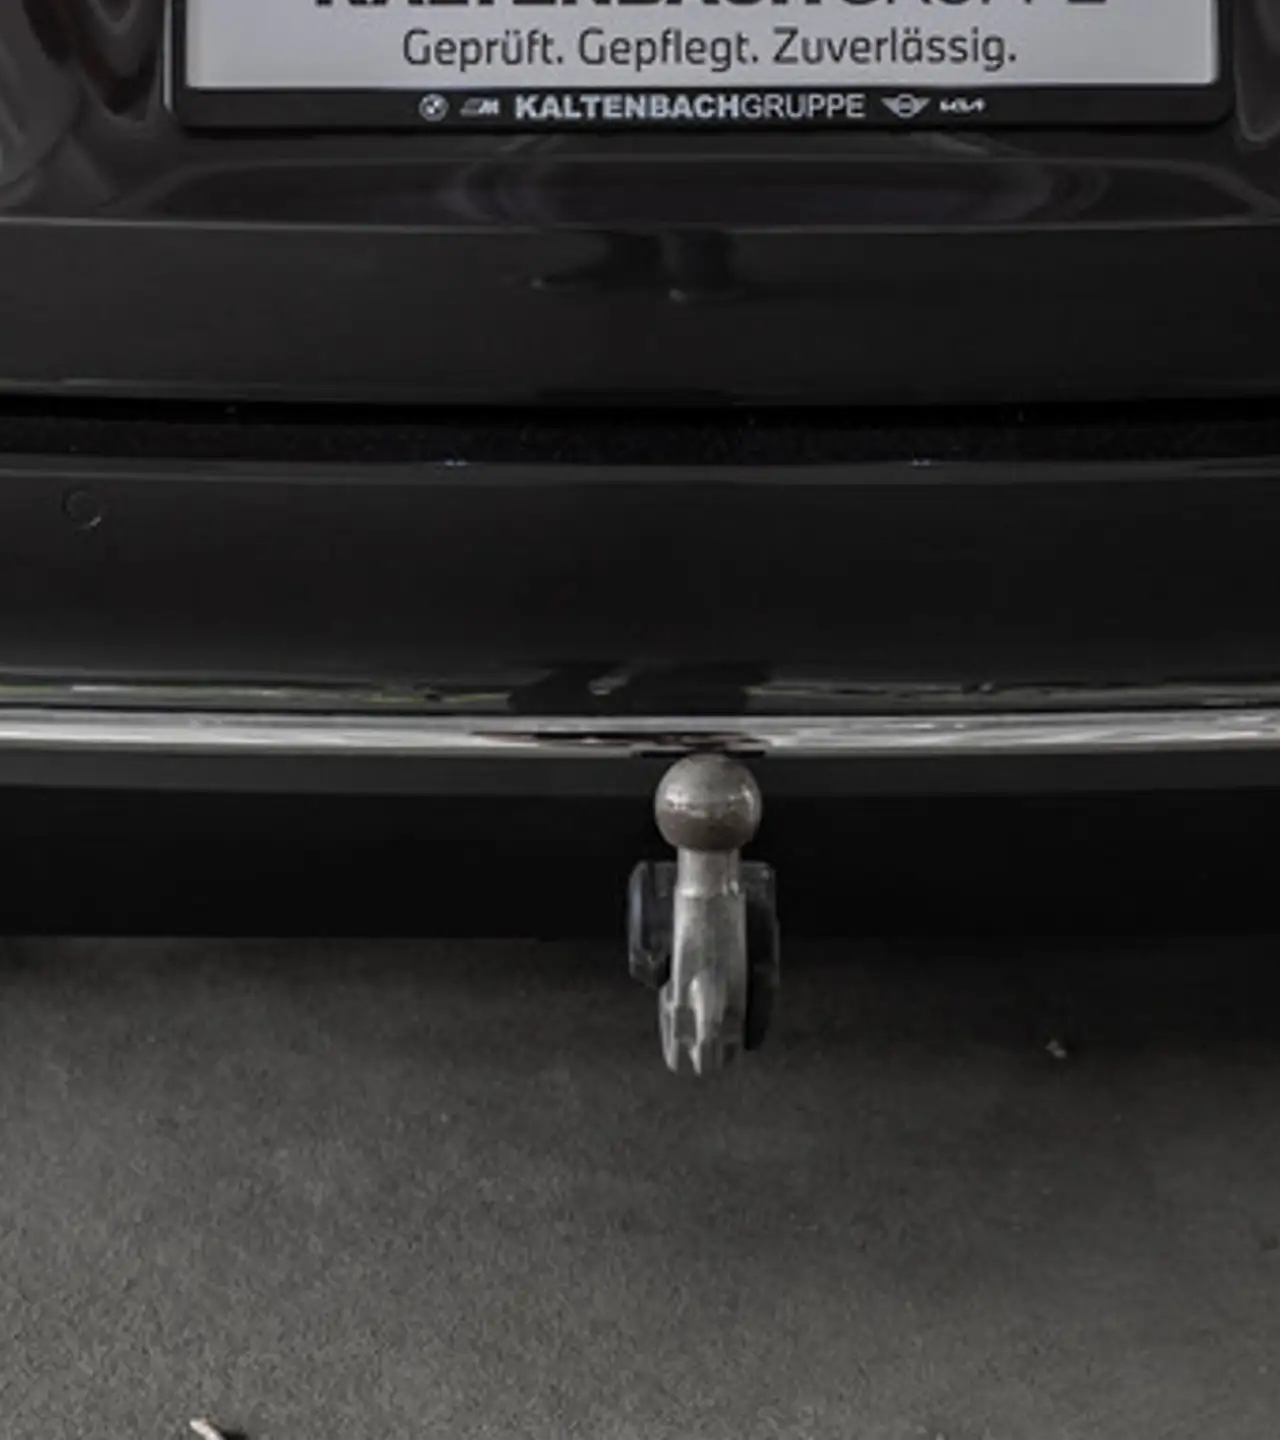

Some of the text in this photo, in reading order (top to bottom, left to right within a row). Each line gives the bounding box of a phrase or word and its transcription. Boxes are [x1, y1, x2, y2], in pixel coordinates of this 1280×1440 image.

[402, 26, 1018, 71] Geprüft. Gepflegt. Zuverlässig.
